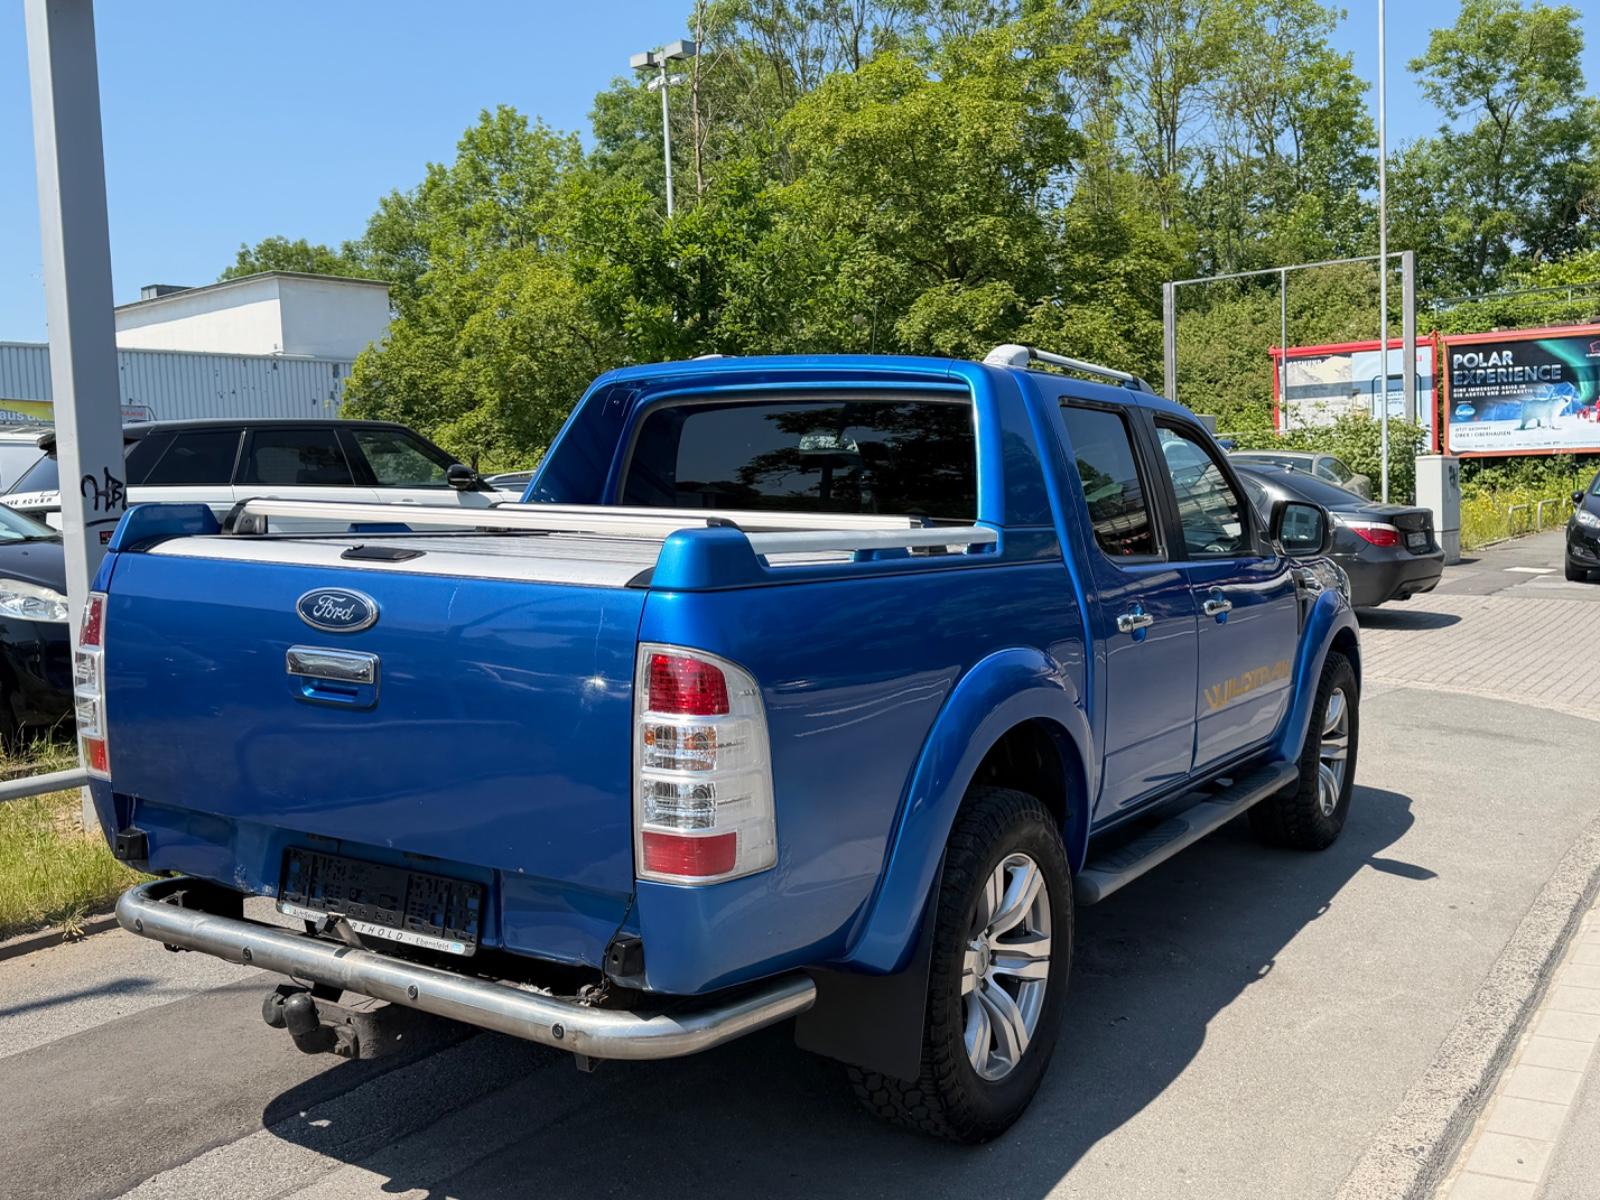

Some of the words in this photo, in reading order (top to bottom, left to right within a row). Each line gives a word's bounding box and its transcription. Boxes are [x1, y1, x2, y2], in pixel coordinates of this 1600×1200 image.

[1453, 350, 1513, 369] POLAR
[1453, 364, 1562, 385] EXPERIENCE
[313, 595, 356, 620] Ford
[351, 921, 404, 941] RTHOLD
